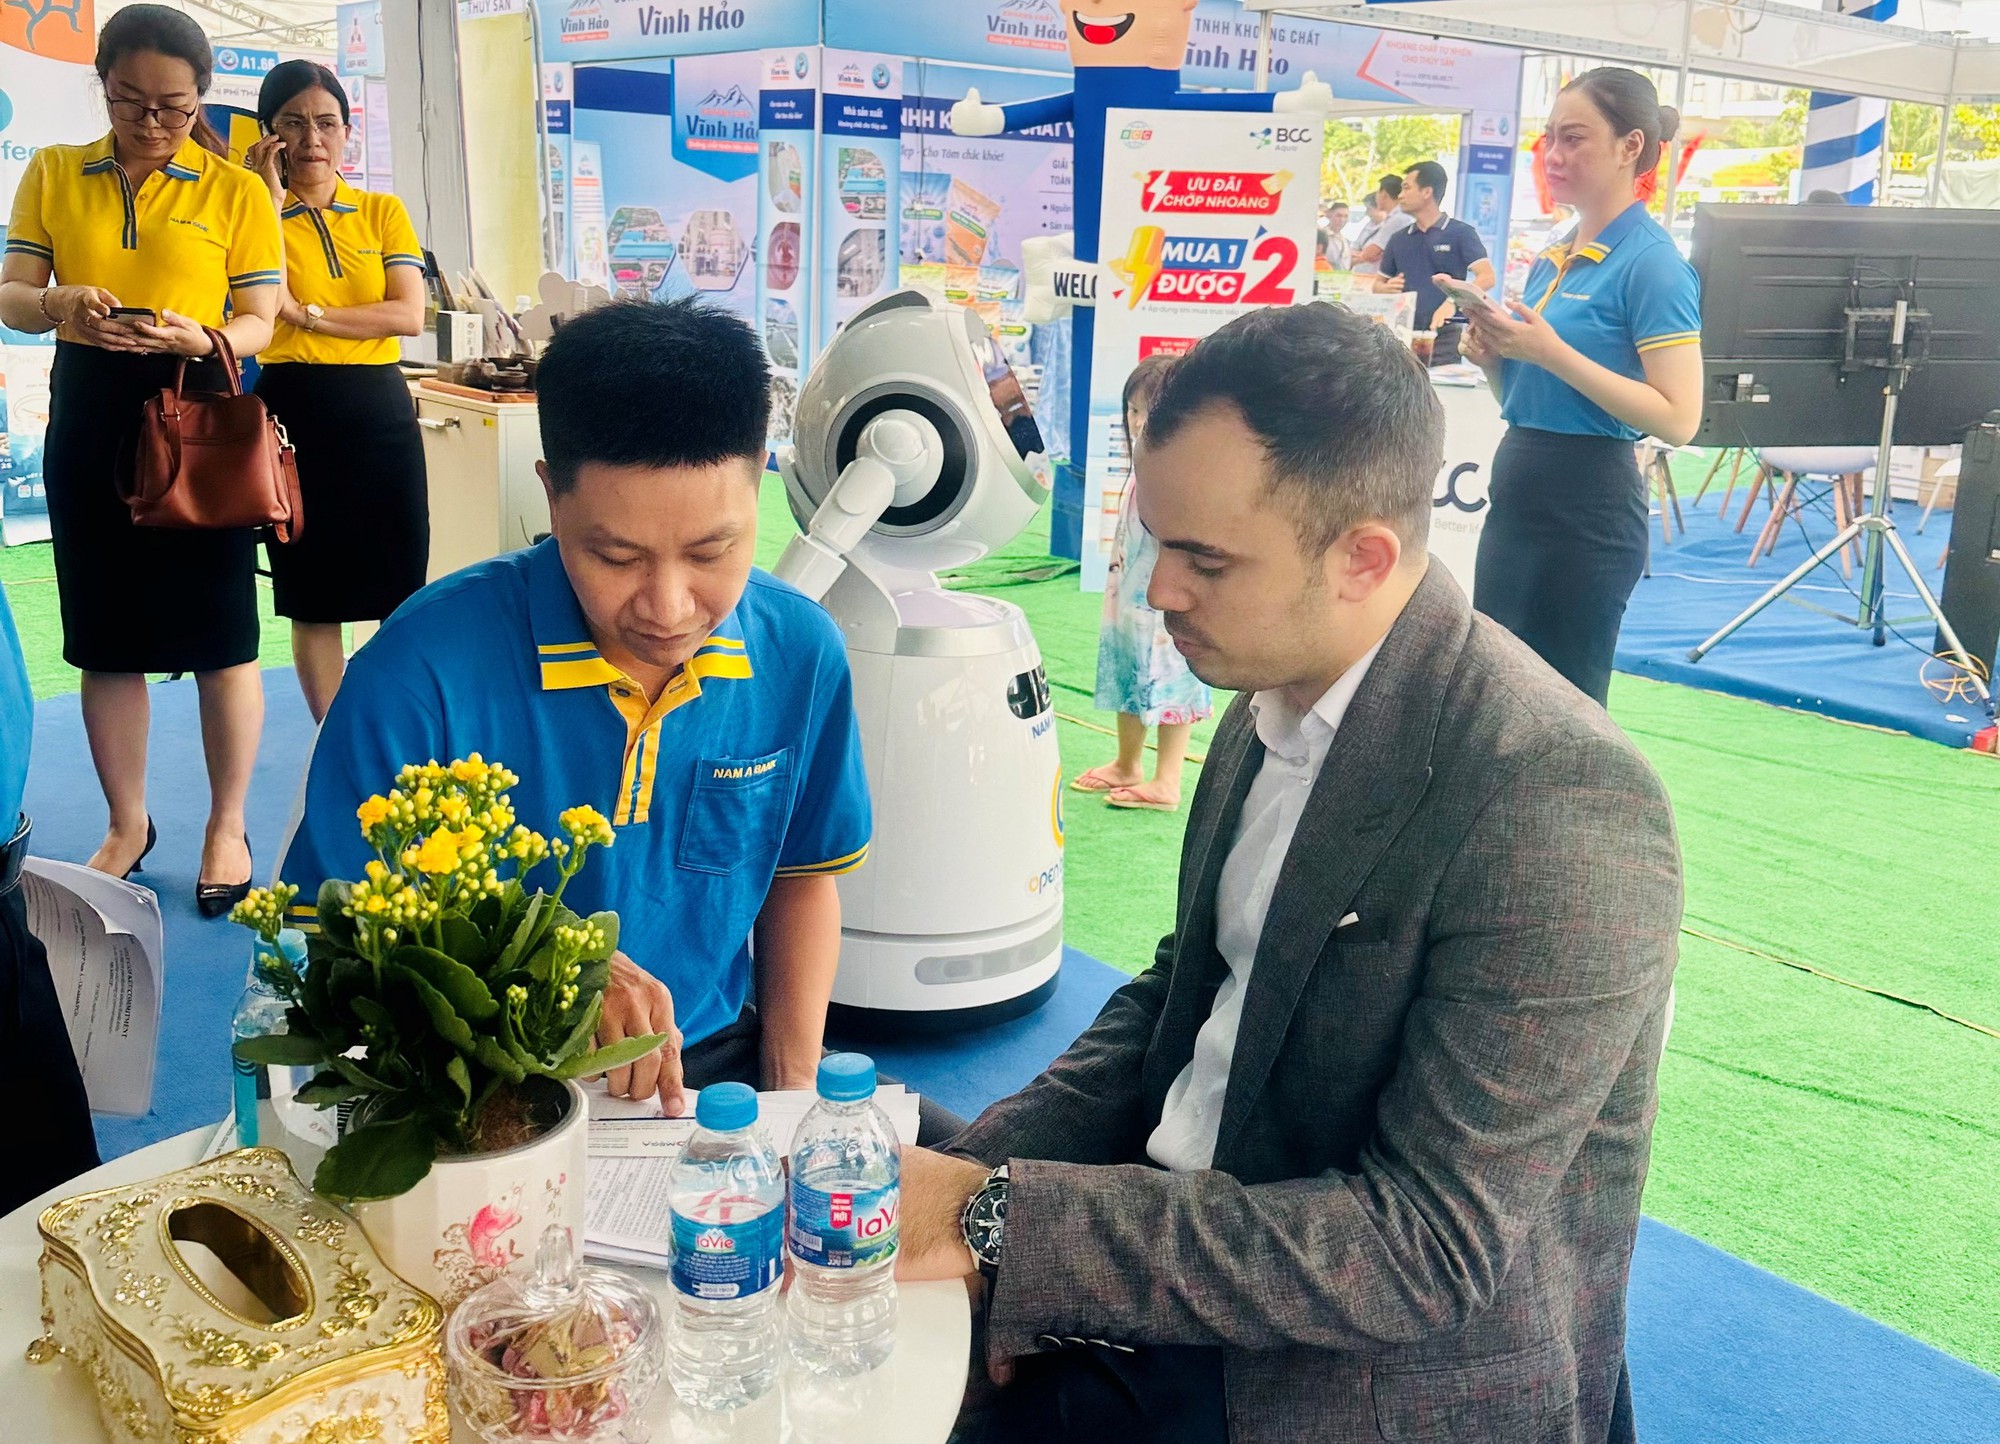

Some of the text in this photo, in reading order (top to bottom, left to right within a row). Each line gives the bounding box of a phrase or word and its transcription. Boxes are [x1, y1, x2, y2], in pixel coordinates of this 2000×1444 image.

[560, 15, 609, 33] Vĩnh Hảo
[638, 0, 745, 36] Vĩnh Hảo
[987, 15, 1067, 40] Vĩnh Hảo
[1195, 18, 1230, 36] TNHH
[1235, 23, 1286, 41] KHONG
[1185, 41, 1230, 69] ĩnh
[686, 114, 727, 138] Vĩnh
[901, 107, 935, 128] NHH
[1276, 128, 1312, 143] BCC
[1275, 144, 1298, 153] Aqua
[1187, 176, 1242, 192] ƯU ĐÃI
[1162, 193, 1205, 207] CHỚP
[1161, 242, 1239, 264] MUA 1
[1240, 236, 1299, 305] 2
[1157, 271, 1238, 300] ĐƯỢC
[1434, 518, 1480, 534] Better lif
[713, 768, 743, 779] NAM
[744, 766, 753, 778] A
[857, 1199, 898, 1239] laV
[696, 1235, 734, 1249] laVie
